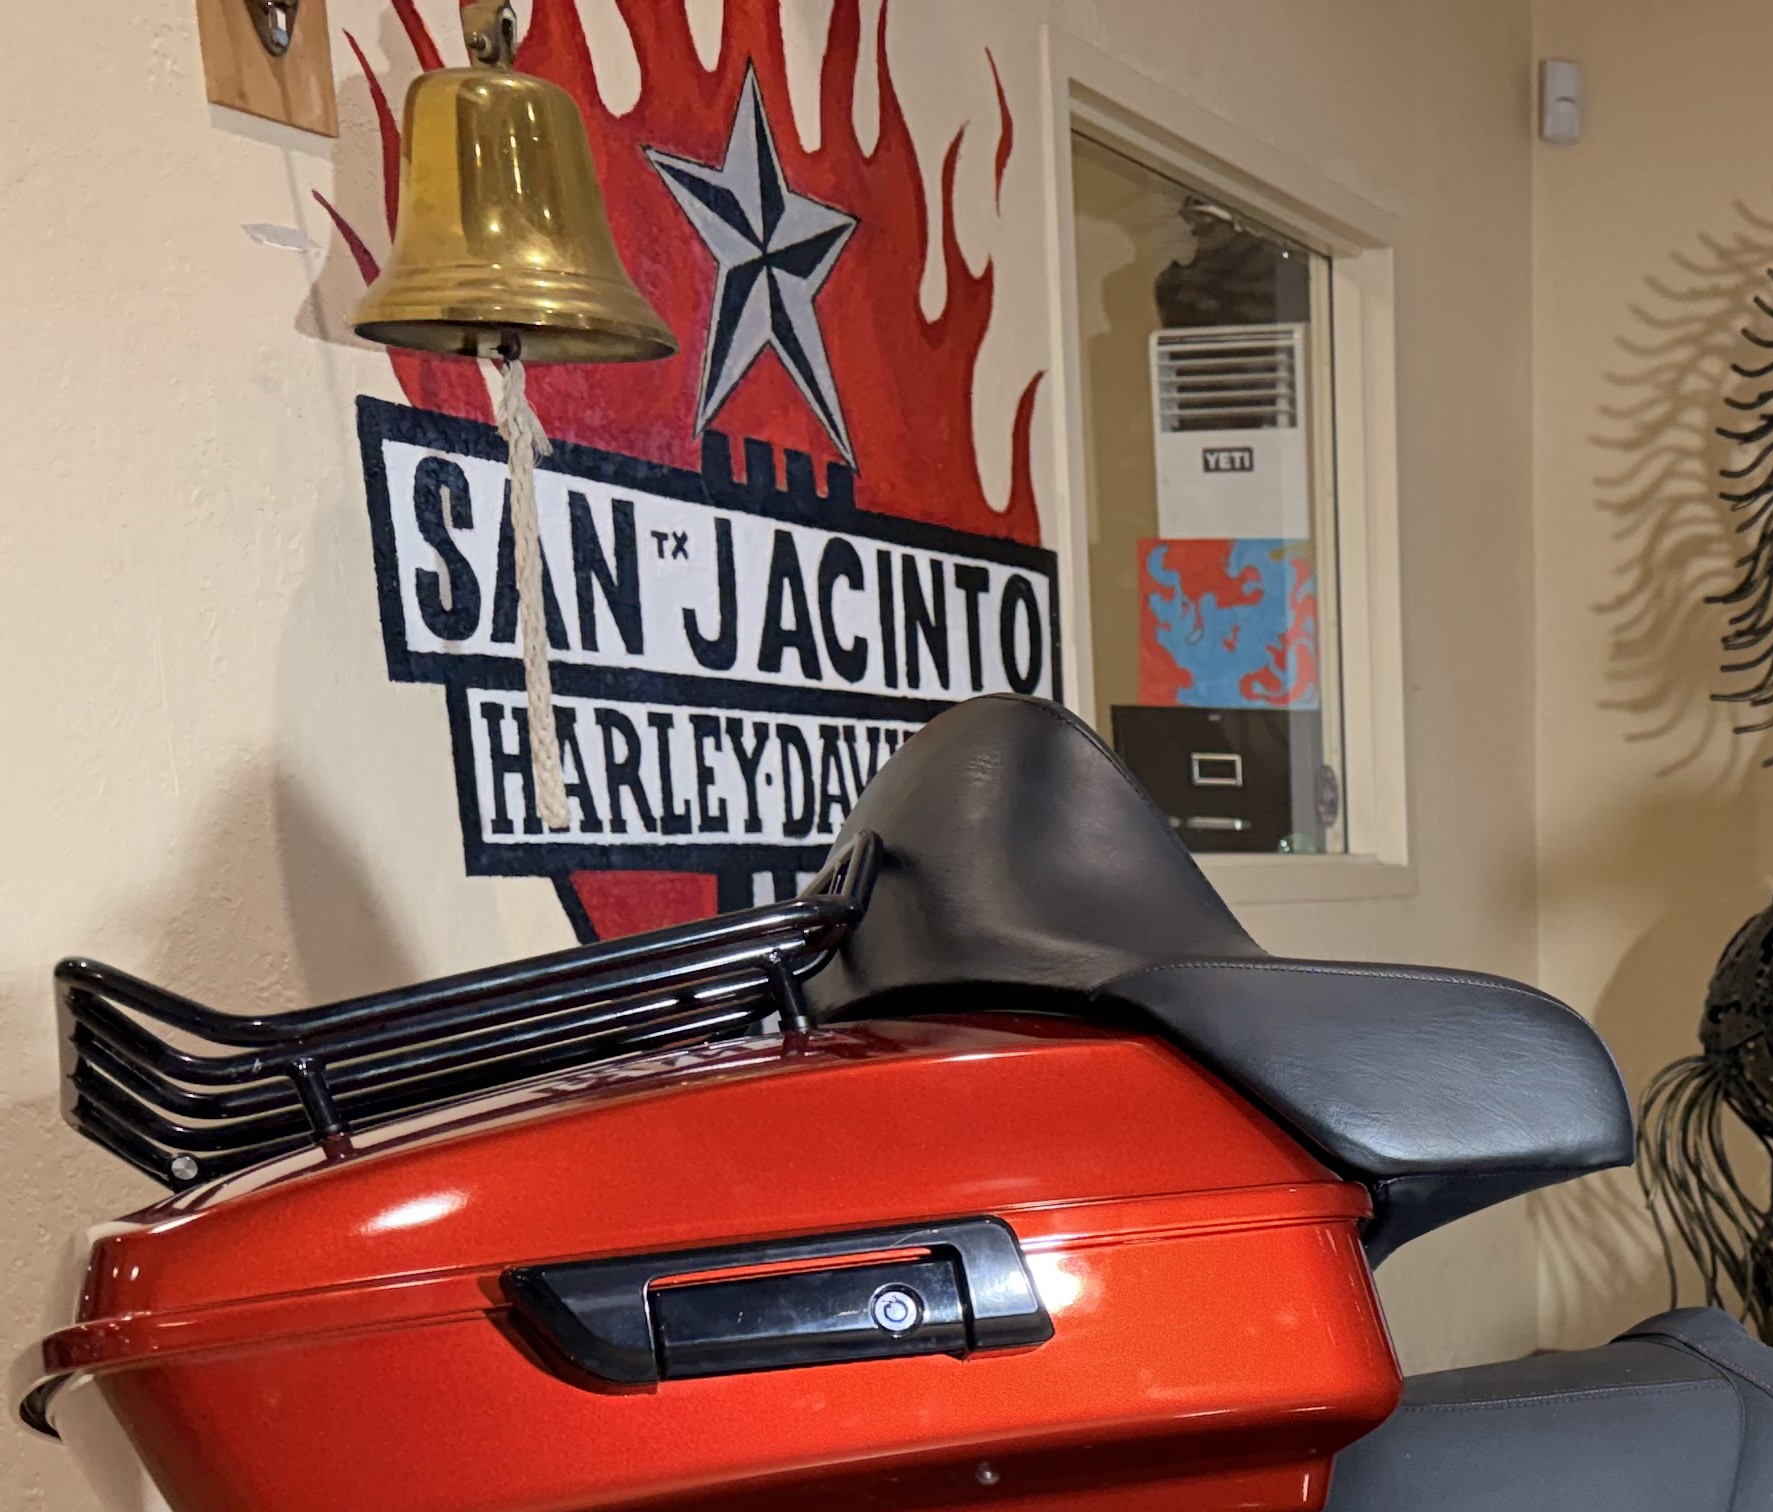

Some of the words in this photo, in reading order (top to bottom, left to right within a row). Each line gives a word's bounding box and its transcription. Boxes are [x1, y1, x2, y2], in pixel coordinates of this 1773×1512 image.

[1205, 451, 1251, 470] YETI
[413, 456, 645, 656] SAN
[650, 529, 690, 561] TX
[683, 517, 1044, 694] JACINTO
